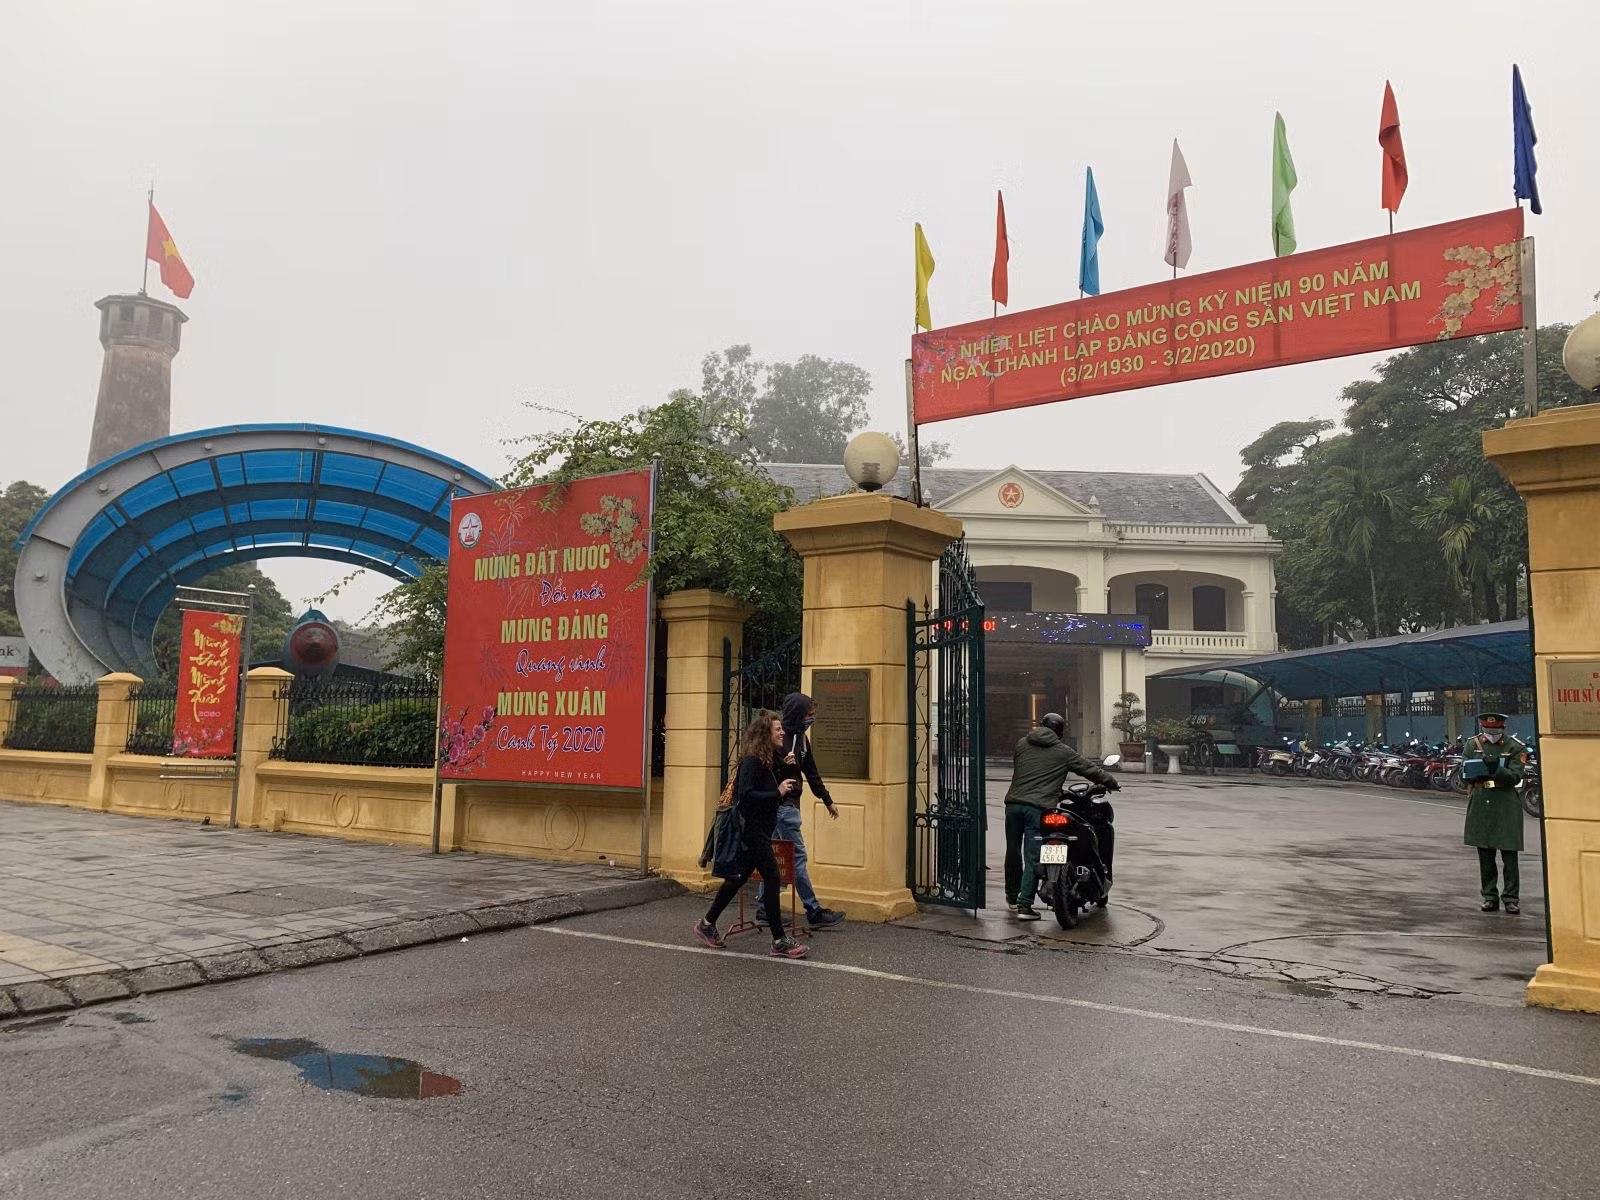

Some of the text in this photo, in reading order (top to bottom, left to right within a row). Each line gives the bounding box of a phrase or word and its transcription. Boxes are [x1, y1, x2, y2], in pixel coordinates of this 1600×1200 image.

[1018, 325, 1057, 348] LIỆT
[1063, 313, 1120, 338] CHÀO
[1126, 302, 1191, 327] MỪNG
[1199, 289, 1228, 313] KỶ
[1235, 280, 1291, 306] NIỆM
[1298, 273, 1325, 294] 90
[1333, 260, 1389, 288] NĂM
[994, 347, 1058, 376] THÀNH
[1064, 339, 1102, 362] LẬP
[1107, 329, 1167, 353] ĐẢNG
[1174, 314, 1239, 342] CỘNG
[1246, 303, 1294, 328] SẢN
[1301, 292, 1355, 318] VIỆT
[1363, 280, 1421, 308] NAM
[1060, 354, 1144, 388] (3/2/1930
[1163, 335, 1255, 367] 3/2/2020)
[474, 540, 610, 582] MỪNG ĐẤT NƯỚC
[501, 608, 609, 644] MỪNG ĐẢNG
[516, 644, 606, 682] Quang vinh
[497, 686, 606, 716] MỪNG XUÂN
[1557, 688, 1580, 707] LỊCH
[496, 724, 537, 751] Canh
[561, 726, 605, 753] 2020
[521, 769, 550, 777] HAPPY
[577, 772, 601, 780] YEAR
